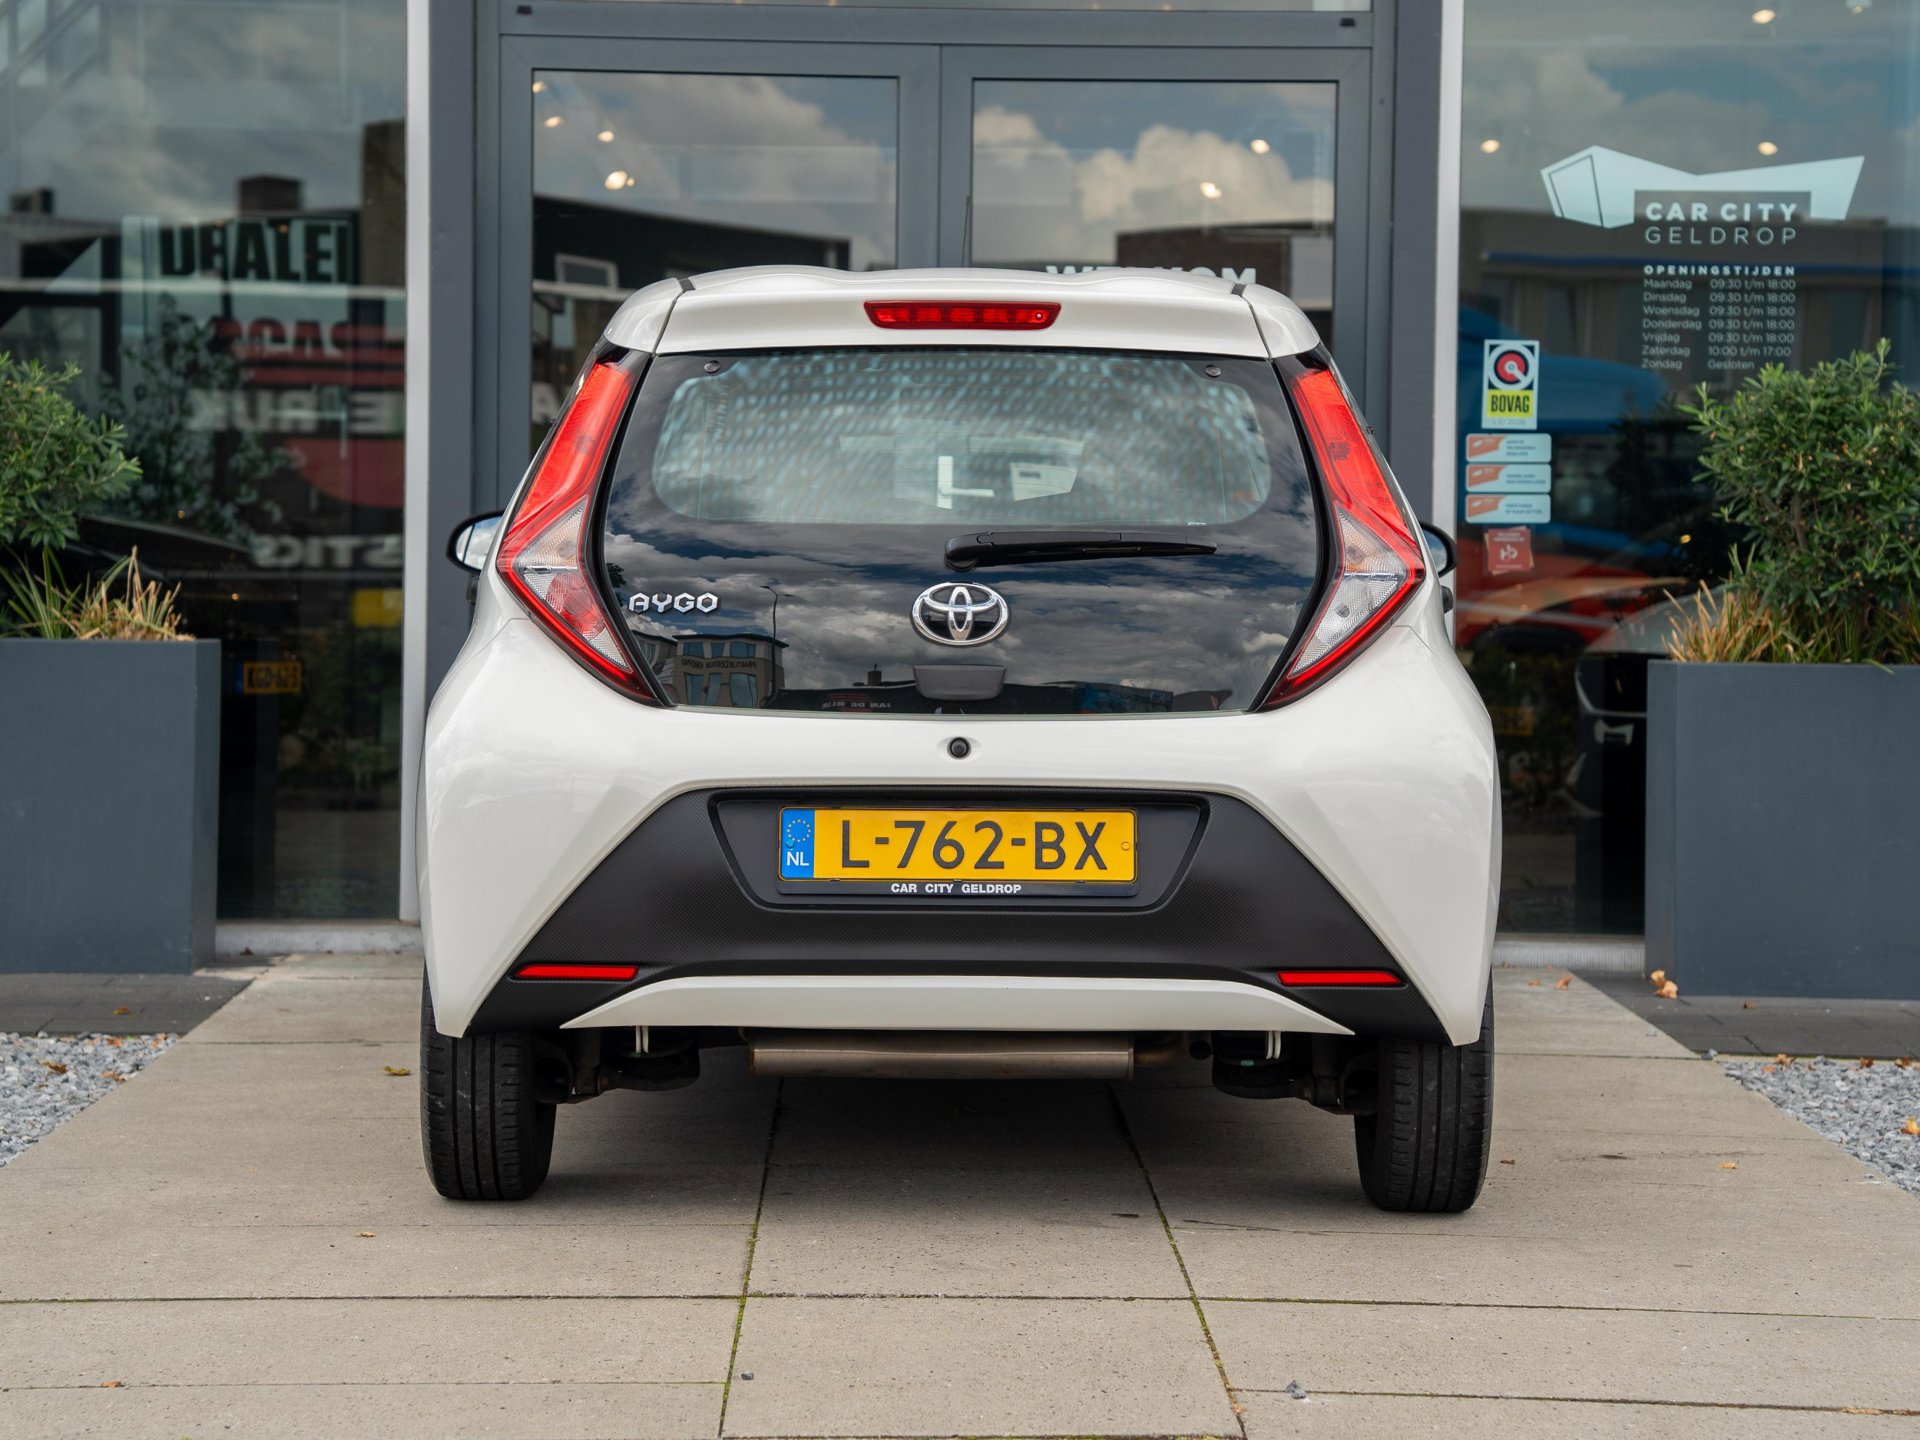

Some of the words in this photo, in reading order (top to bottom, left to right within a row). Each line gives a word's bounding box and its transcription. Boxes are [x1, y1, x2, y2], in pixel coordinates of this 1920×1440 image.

[1645, 202, 1708, 221] CAR
[1719, 202, 1797, 222] CITY
[1645, 226, 1797, 245] GELDROP
[1643, 264, 1795, 276] OPENINGSTIJDEN
[1644, 279, 1692, 290] Maandag
[1643, 292, 1687, 303] Dinsdag
[1643, 305, 1700, 316] Woensdag
[1642, 319, 1702, 330] Donderdag
[1642, 332, 1680, 343] Vrijdag
[1641, 345, 1690, 357] Zaterdag
[1641, 359, 1682, 370] Zondag
[1707, 359, 1755, 370] Gesloten
[1490, 394, 1530, 413] BOVAG
[628, 591, 721, 614] AYGO
[841, 819, 1109, 871] L-762-BX
[786, 851, 810, 867] NL
[891, 883, 918, 894] CAR
[925, 883, 954, 894] CITY
[961, 883, 1022, 894] GELDROP
